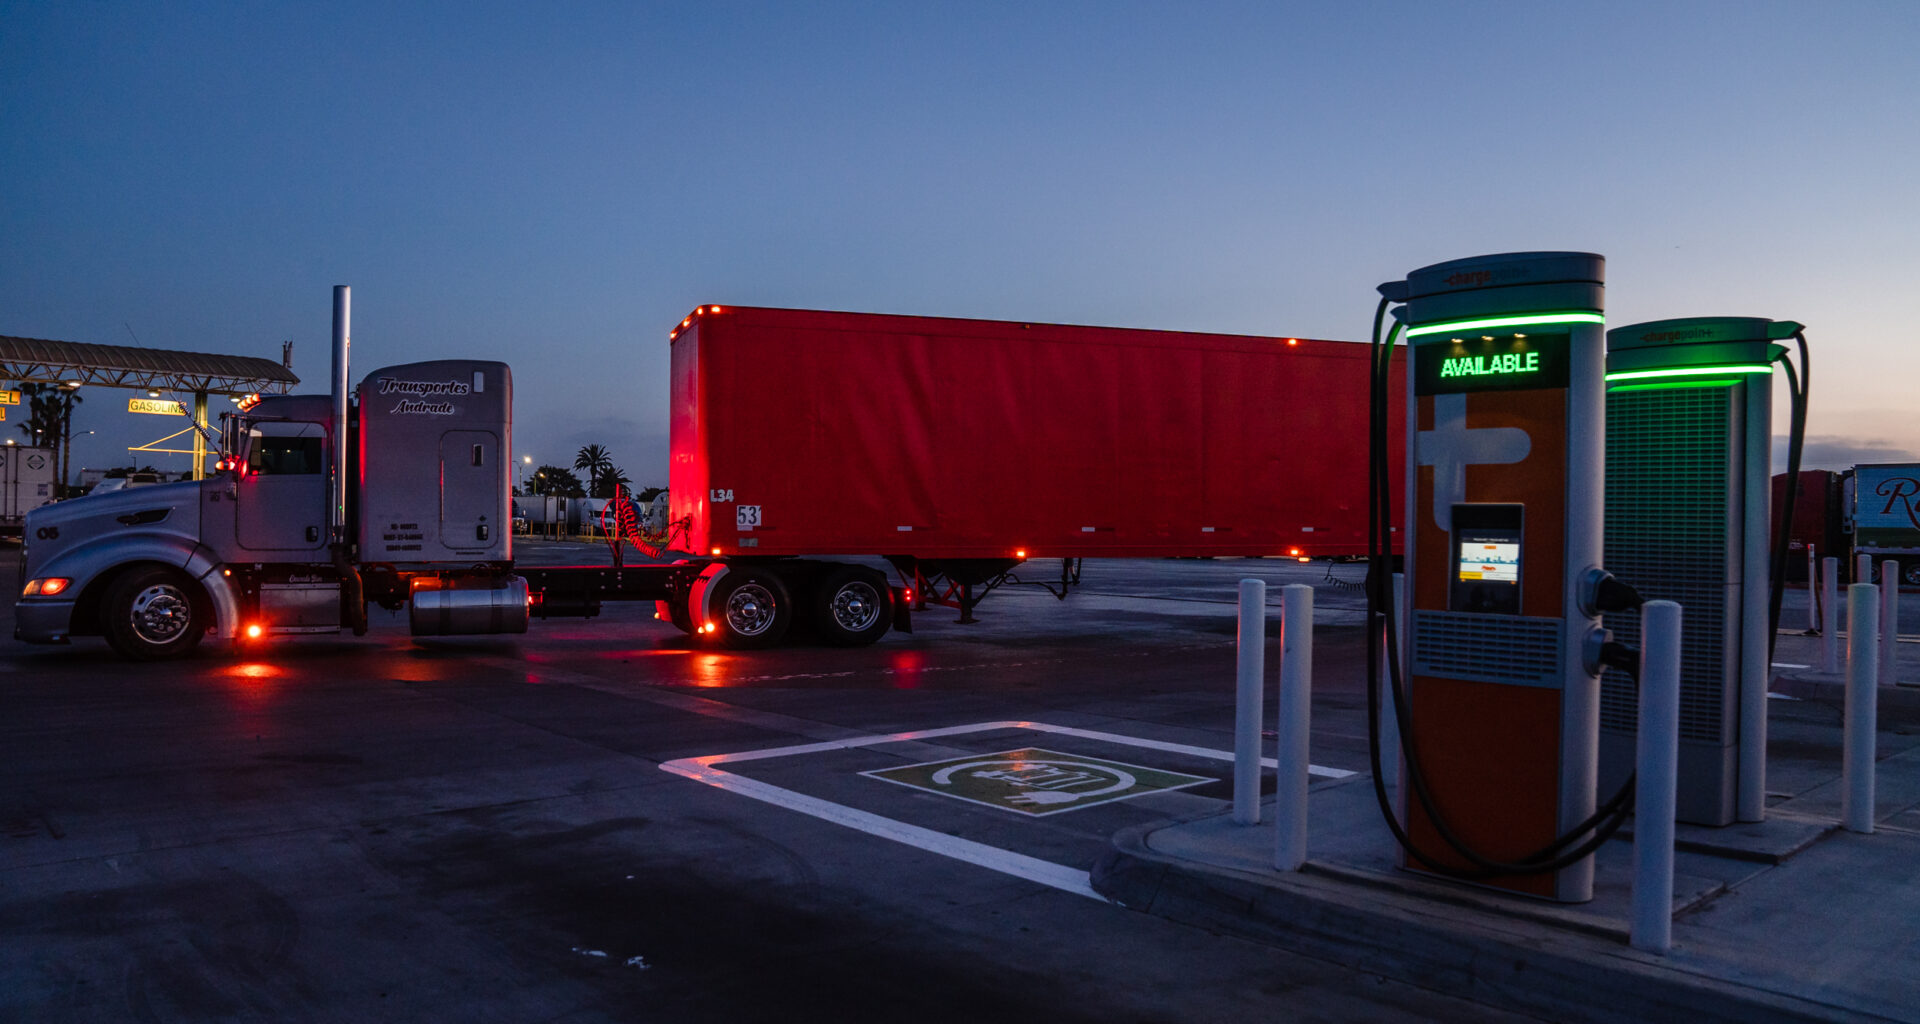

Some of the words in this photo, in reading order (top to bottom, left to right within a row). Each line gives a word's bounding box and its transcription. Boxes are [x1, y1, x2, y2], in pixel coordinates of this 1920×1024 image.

[1440, 352, 1539, 378] AVAILABLE
[377, 376, 470, 397] Transportes
[390, 399, 455, 415] Andrade
[710, 489, 734, 502] L34
